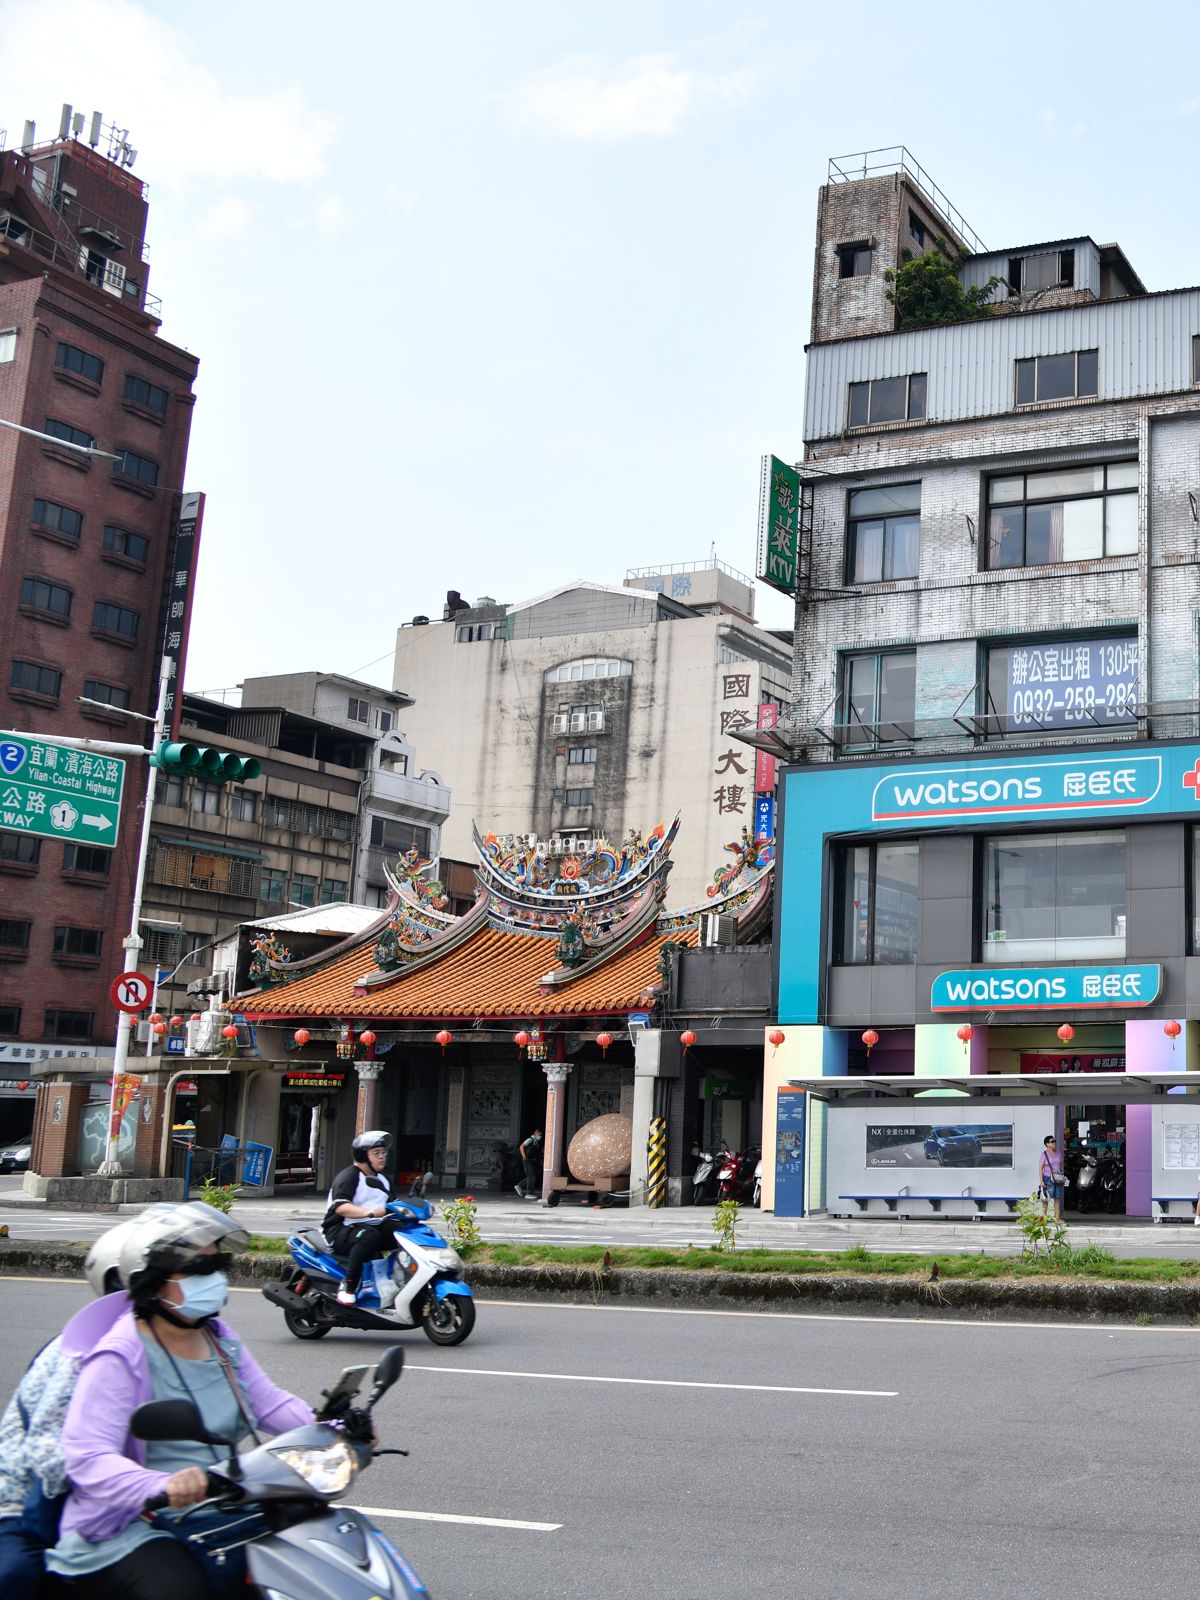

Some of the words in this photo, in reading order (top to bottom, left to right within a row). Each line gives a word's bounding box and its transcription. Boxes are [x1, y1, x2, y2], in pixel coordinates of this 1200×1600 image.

[769, 552, 793, 583] KTV
[1013, 646, 1090, 685] 辦公室出租
[1099, 643, 1138, 677] 130坪
[6, 747, 19, 761] 2
[713, 674, 753, 816] 國際大樓
[2, 787, 47, 814] 公路
[86, 780, 116, 798] Highway
[894, 776, 1042, 807] watsons
[1064, 769, 1137, 797] 屈臣氏
[0, 811, 34, 828] WAY
[946, 976, 1066, 1002] watsons
[1083, 973, 1142, 999] 屈臣氏
